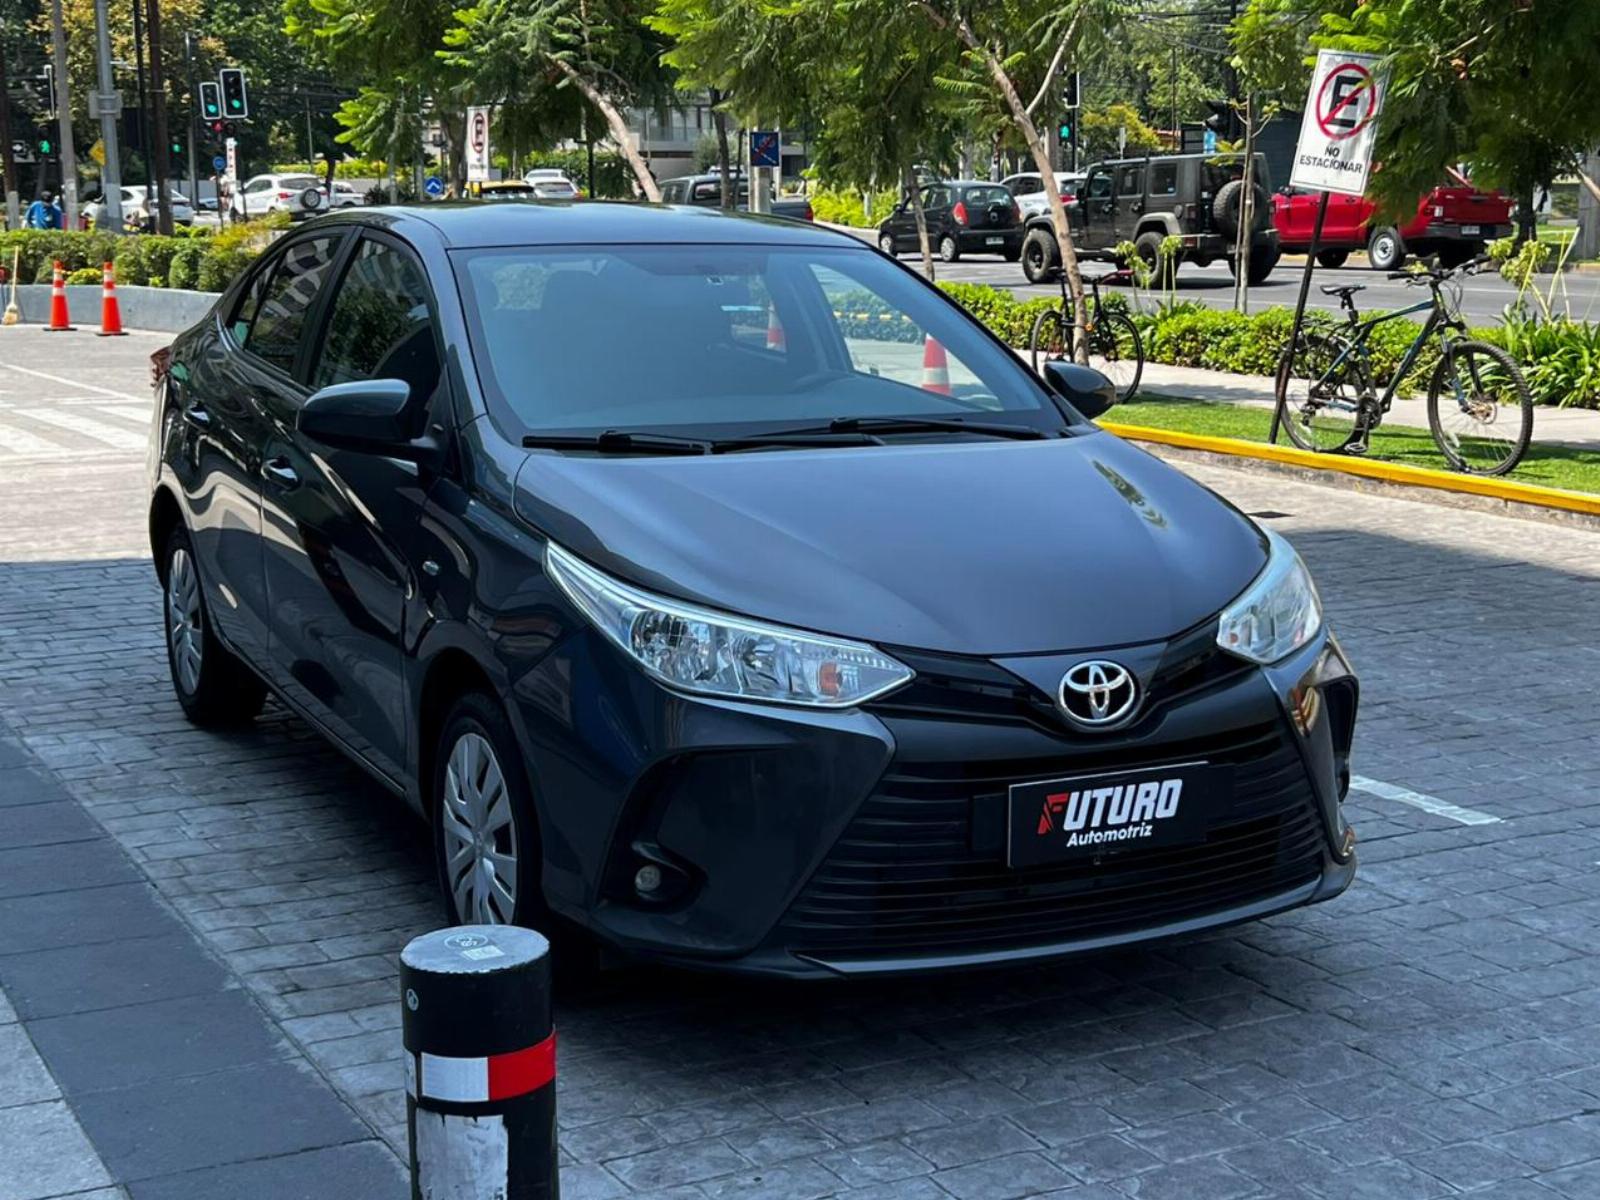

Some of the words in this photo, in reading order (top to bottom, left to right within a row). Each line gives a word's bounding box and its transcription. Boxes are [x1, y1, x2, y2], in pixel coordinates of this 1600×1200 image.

[1326, 75, 1366, 128] E
[1299, 154, 1363, 174] ESTACIONAR
[1324, 146, 1340, 158] NO
[1037, 778, 1183, 835] FUTURO
[1066, 822, 1153, 848] Automotriz
